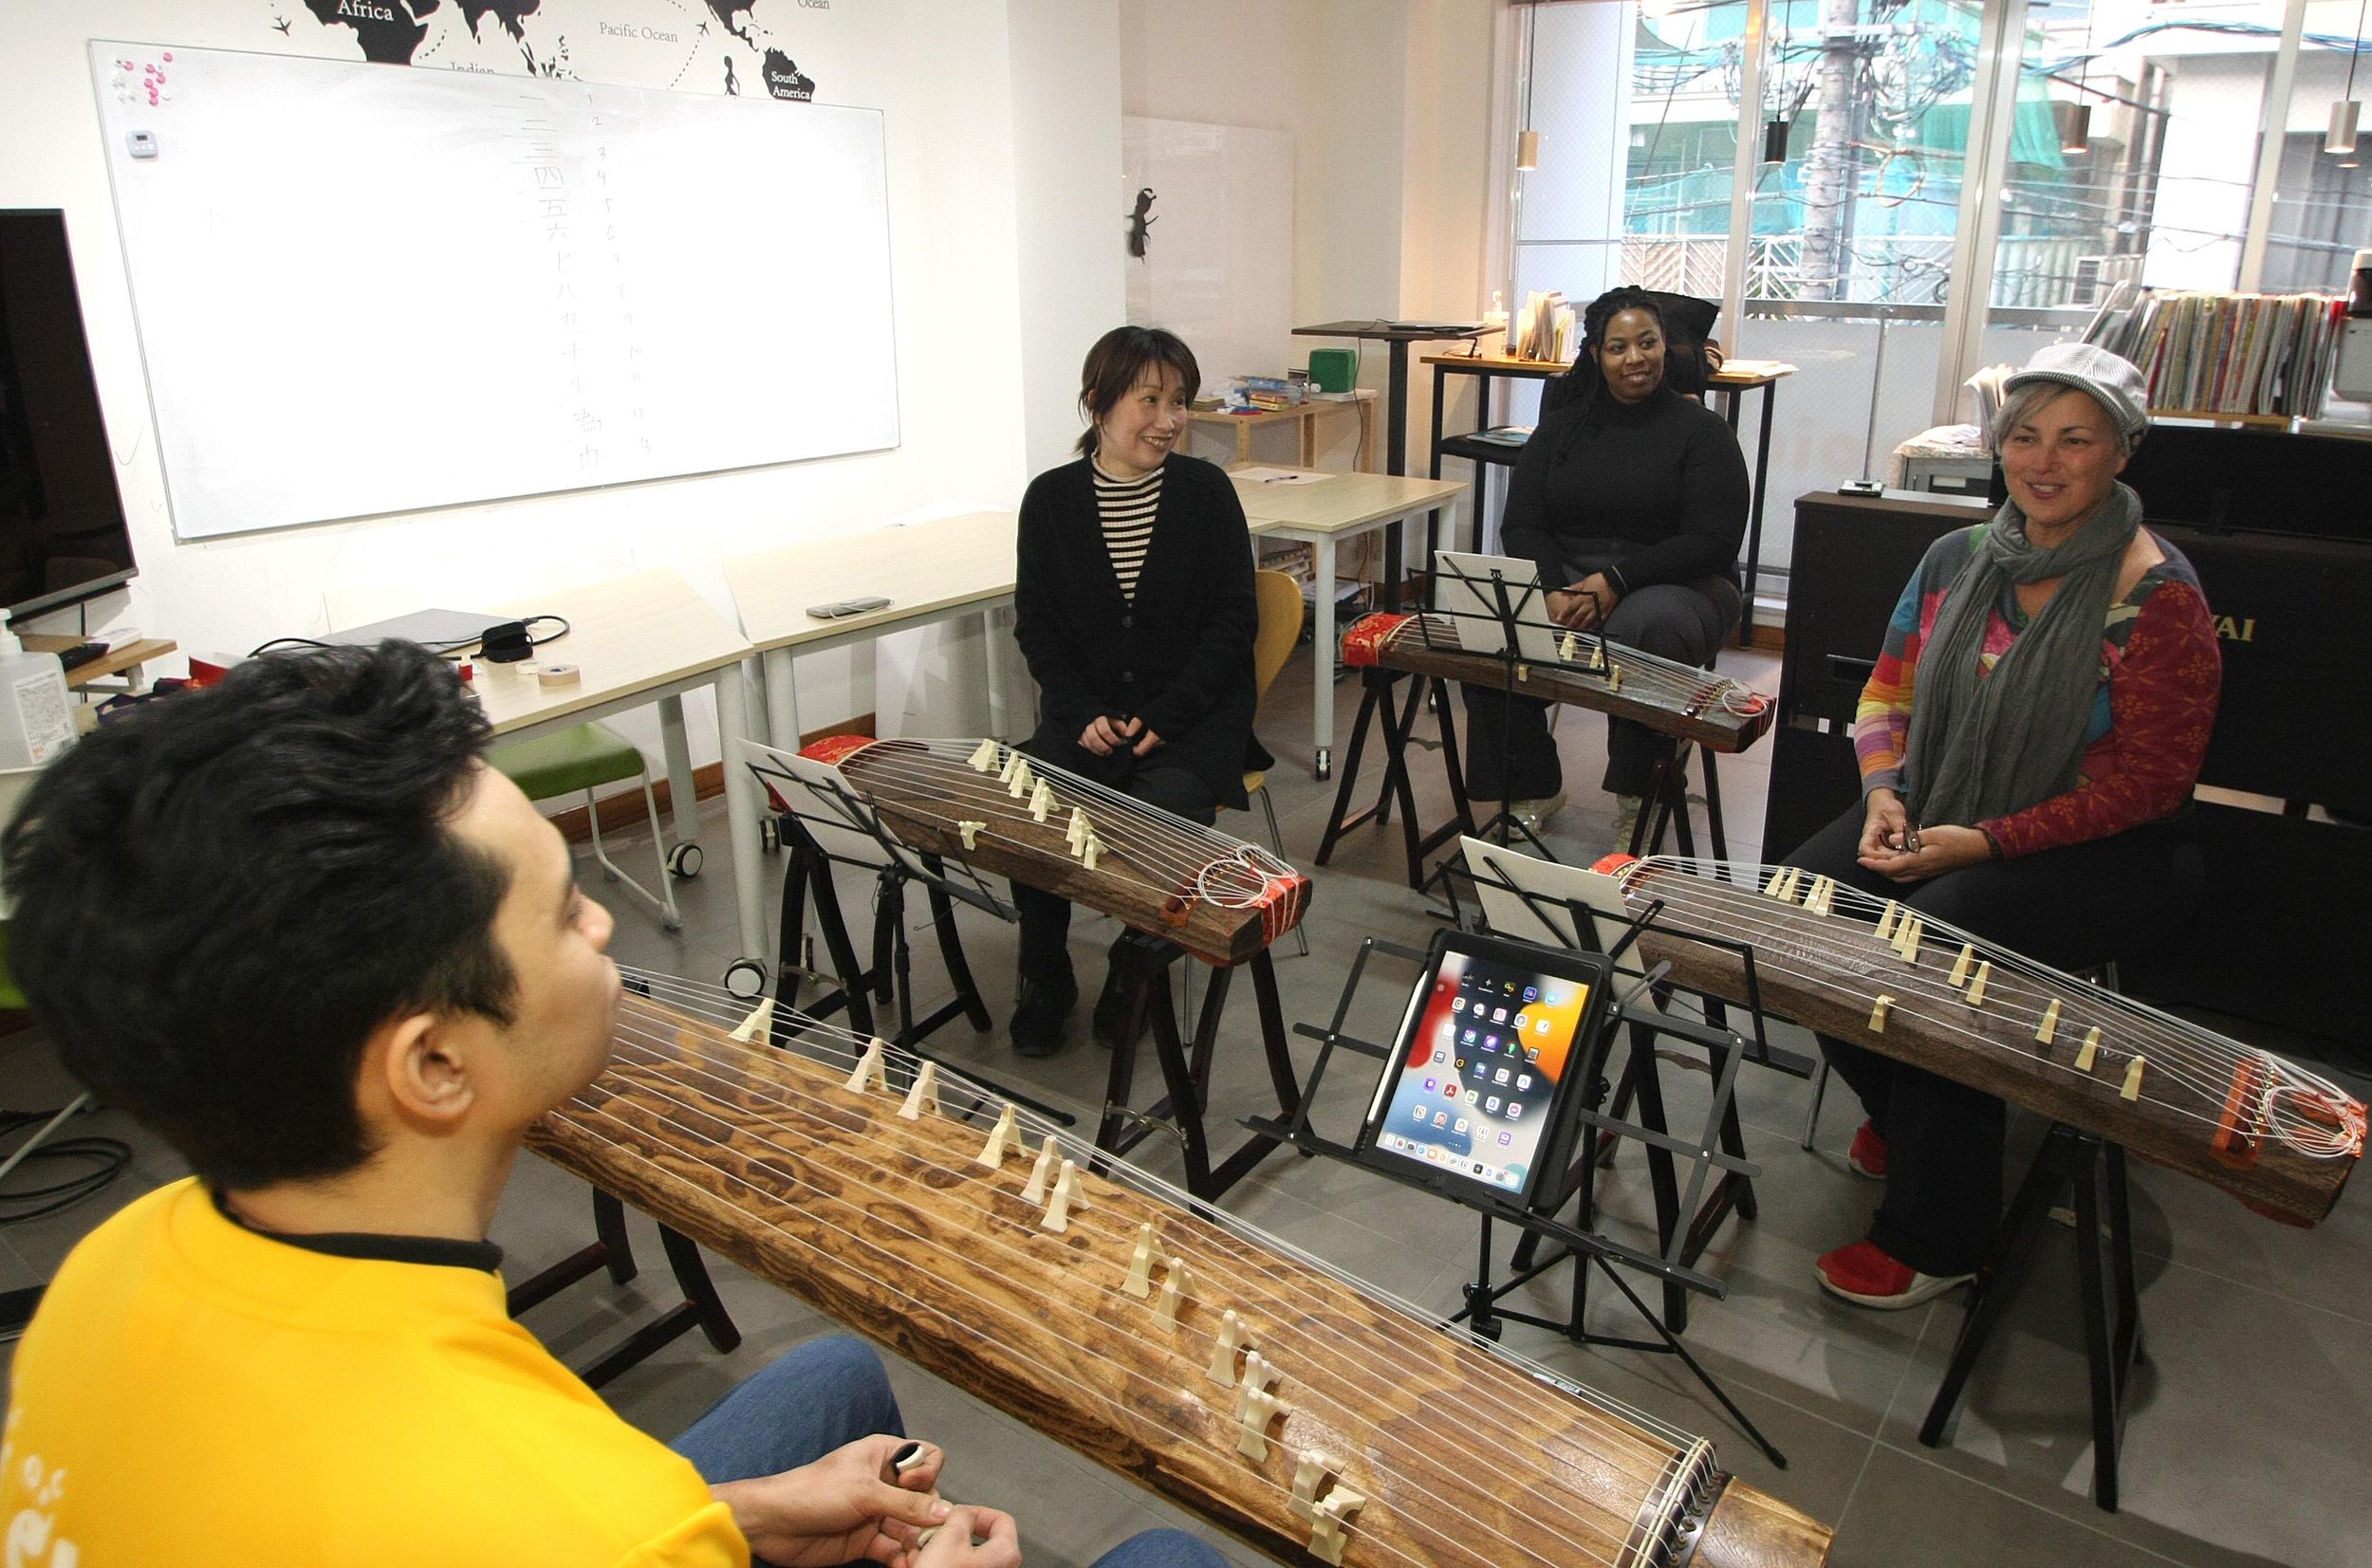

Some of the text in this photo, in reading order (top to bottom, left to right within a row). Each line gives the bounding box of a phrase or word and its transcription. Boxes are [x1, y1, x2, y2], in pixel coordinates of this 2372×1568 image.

[338, 0, 394, 21] Africa
[797, 0, 830, 9] Ocean
[600, 22, 678, 43] Pacific Ocean
[771, 70, 799, 84] South
[773, 85, 810, 100] America
[539, 199, 569, 218] 五
[547, 222, 569, 243] 六
[2212, 615, 2257, 642] AI
